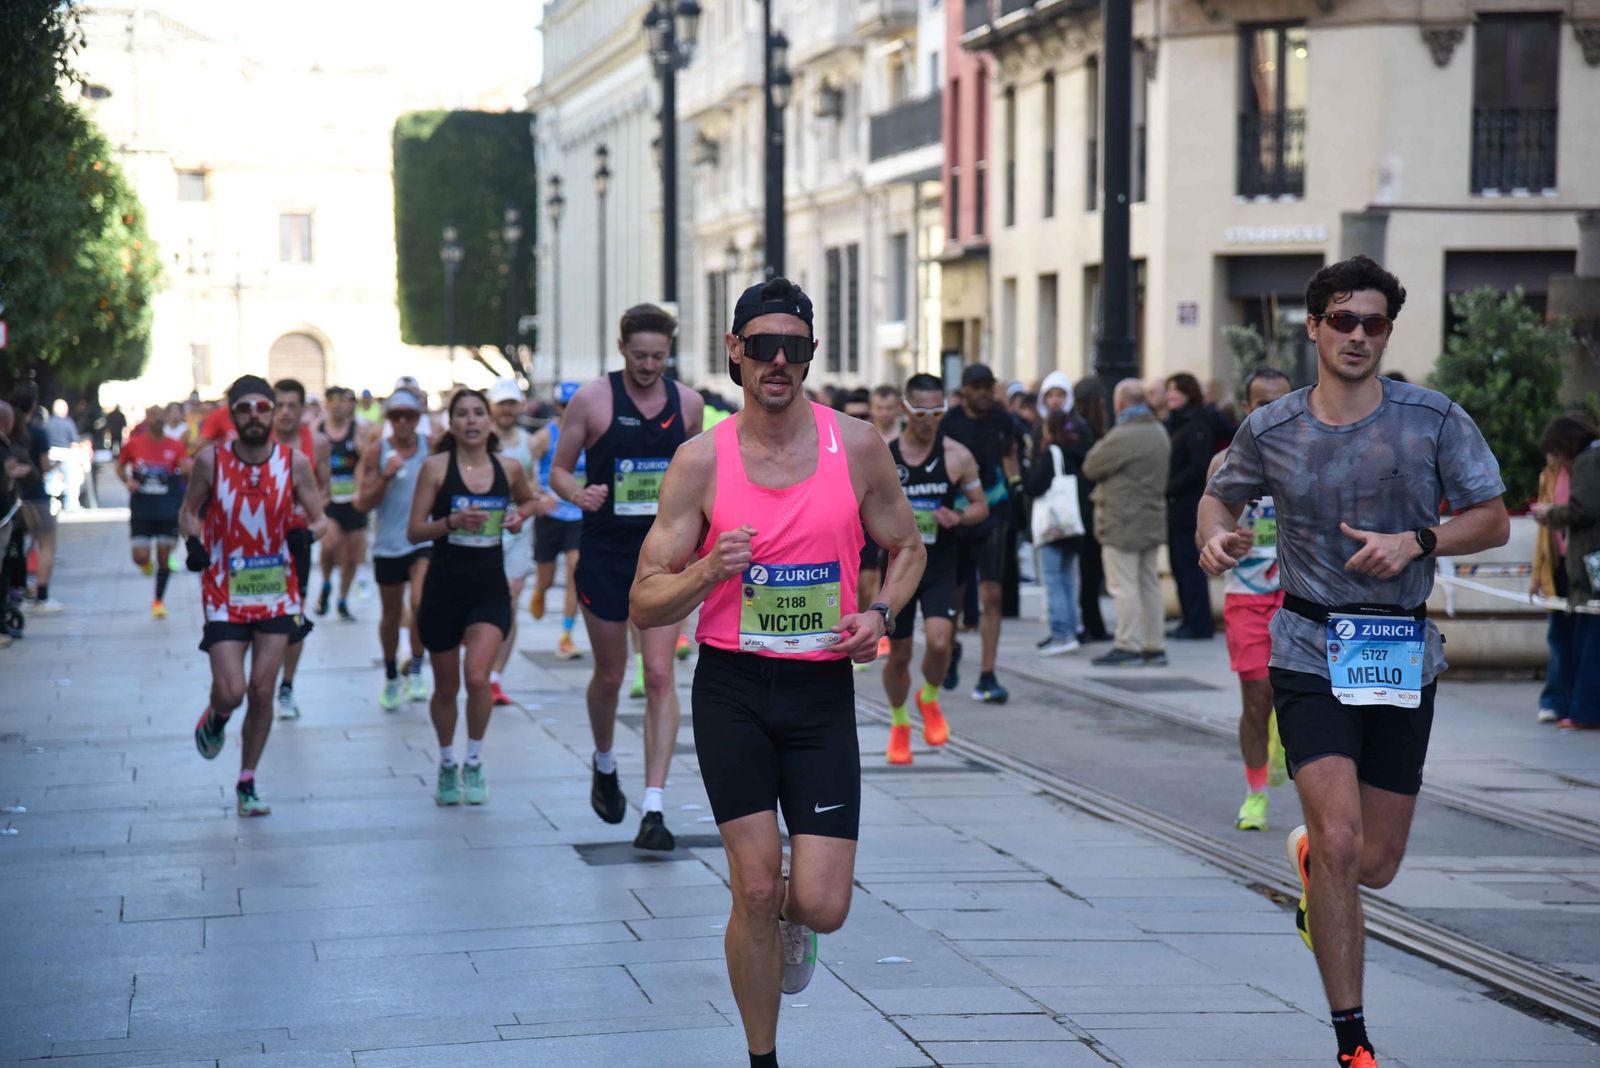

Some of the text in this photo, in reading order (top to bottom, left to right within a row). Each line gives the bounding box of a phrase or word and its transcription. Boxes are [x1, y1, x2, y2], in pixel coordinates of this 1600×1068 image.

[775, 568, 829, 582] ZURICH
[776, 596, 806, 609] 2188
[758, 612, 823, 632] VICTOR
[1361, 625, 1414, 636] ZURICH
[1361, 649, 1389, 661] 5727
[1347, 666, 1403, 685] MELLO
